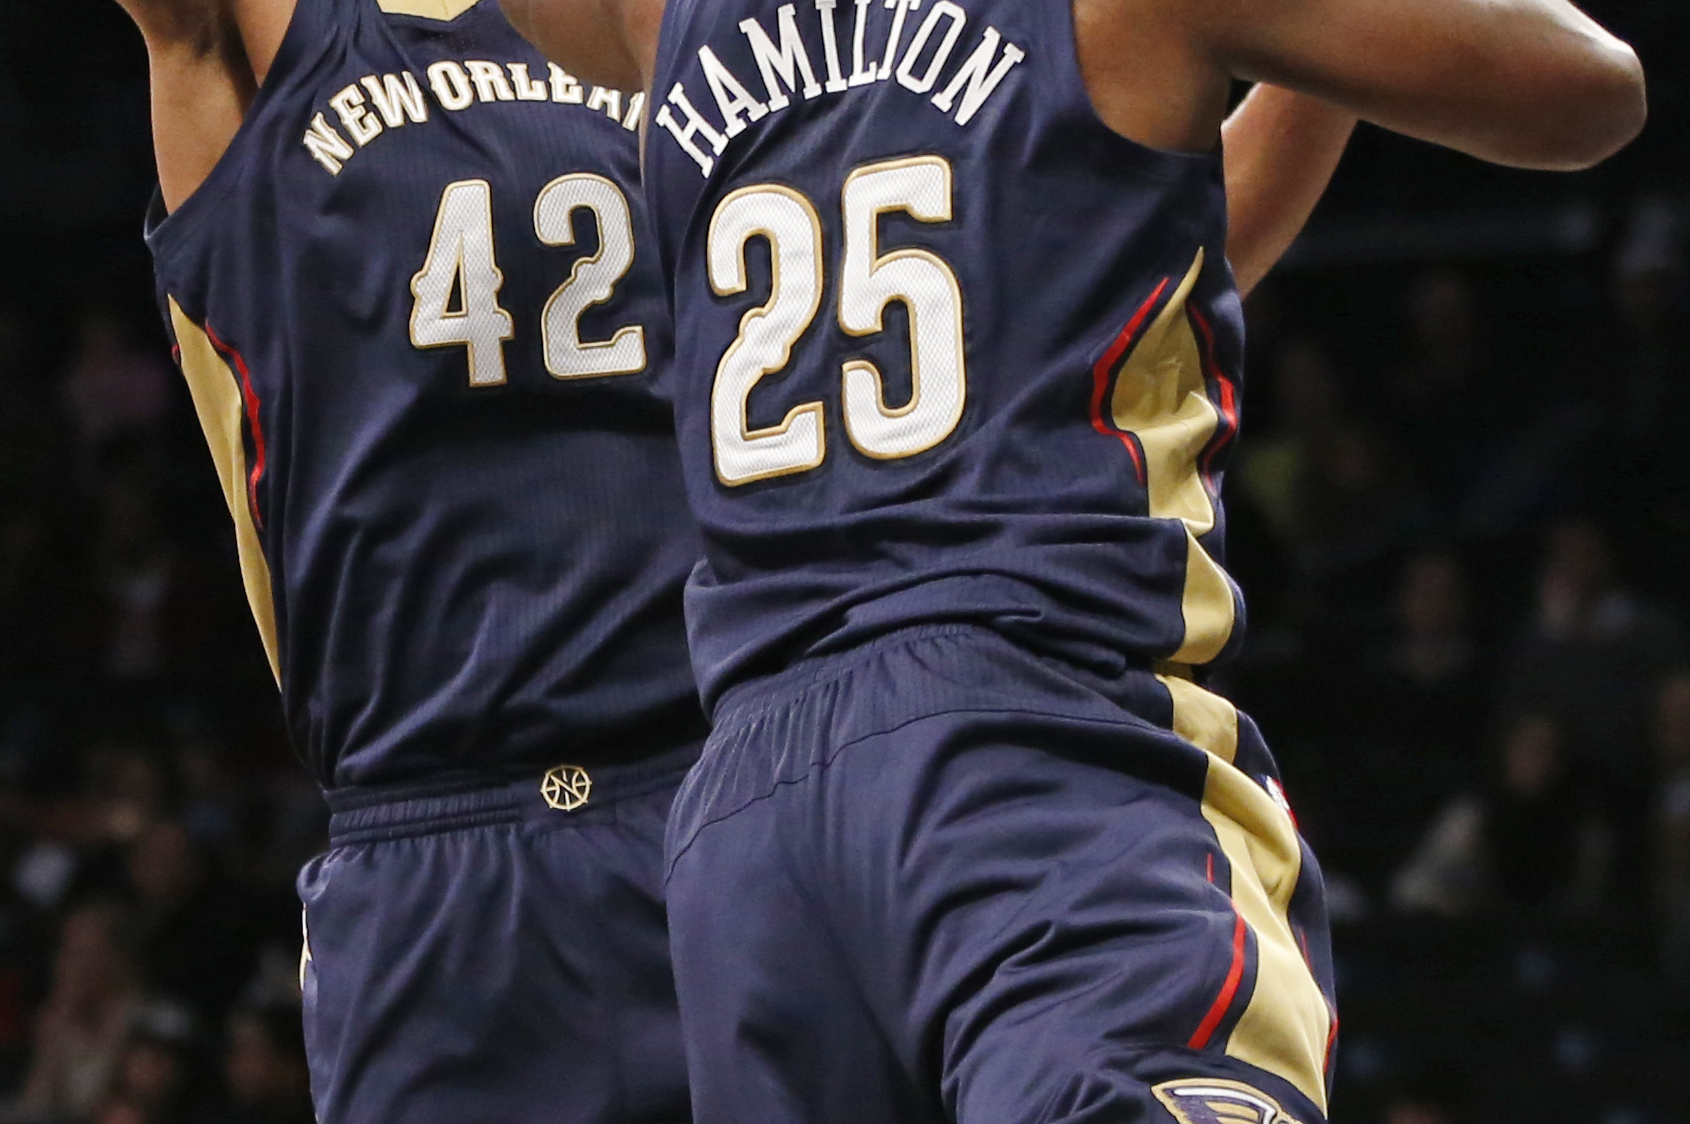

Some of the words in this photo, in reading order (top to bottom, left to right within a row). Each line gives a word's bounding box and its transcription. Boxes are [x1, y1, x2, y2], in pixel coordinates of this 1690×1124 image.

[303, 70, 429, 176] NEW
[427, 59, 646, 132] ORLEA
[409, 172, 647, 387] 42
[707, 154, 967, 486] 25
